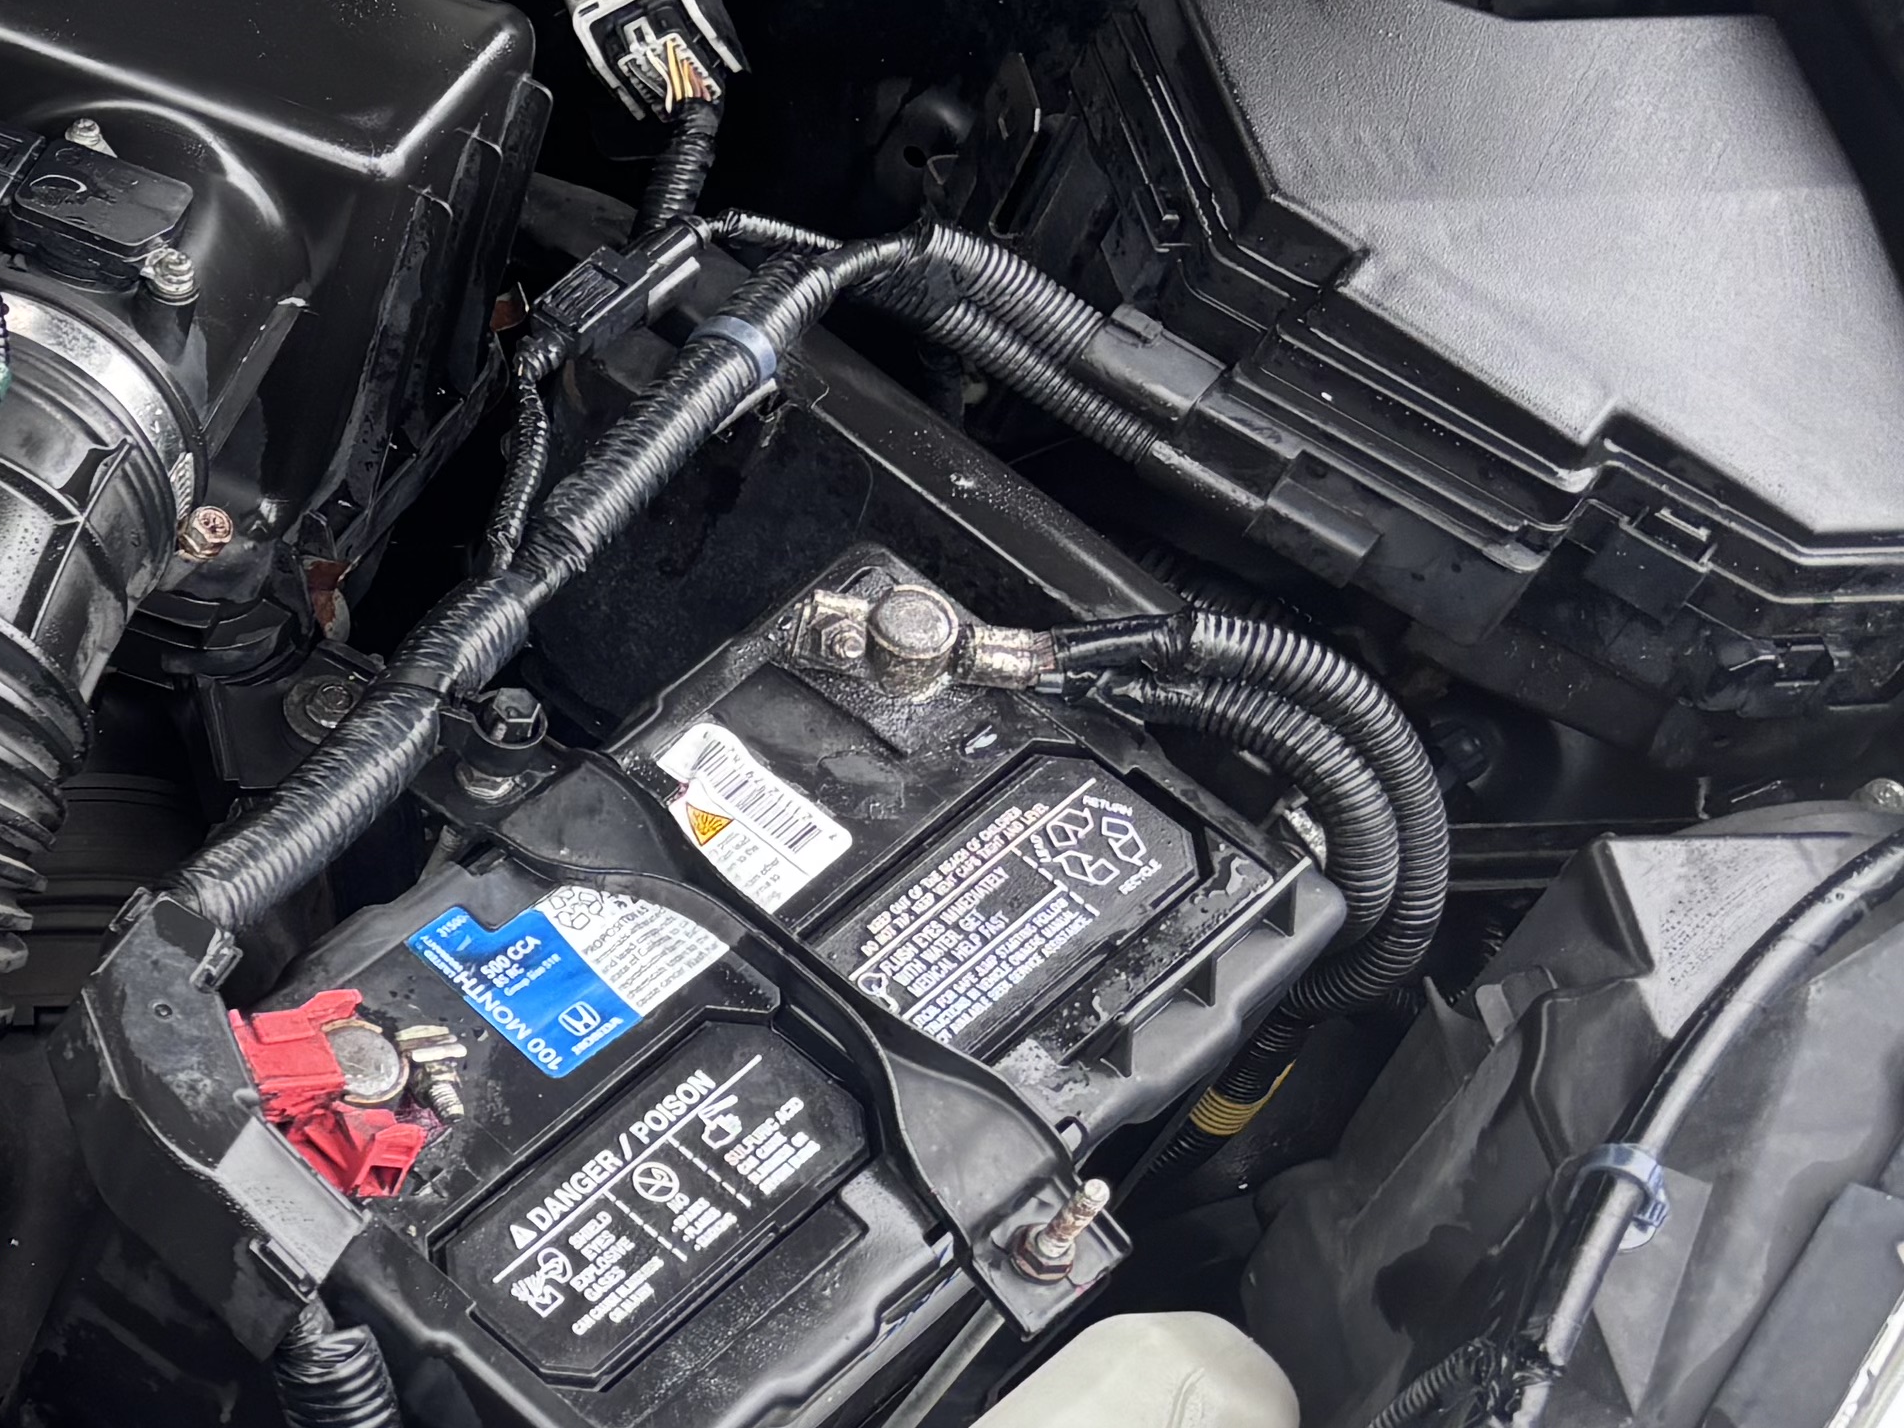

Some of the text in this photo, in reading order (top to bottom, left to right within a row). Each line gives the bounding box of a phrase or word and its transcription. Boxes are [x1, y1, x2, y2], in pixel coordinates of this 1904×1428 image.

[1082, 795, 1133, 817] RETURN
[860, 938, 879, 957] DO
[874, 923, 897, 946] NOT
[1002, 818, 1026, 841] AND
[1118, 858, 1162, 895] RECYCLE
[878, 864, 1010, 978] FLUSH EYES IMMEDIATELY
[892, 955, 927, 988] WITH
[957, 907, 985, 934] GET
[479, 930, 541, 981] 500 CCA
[906, 909, 1010, 999] MEDICAL HELP FAST
[453, 968, 532, 1041] MONTH
[526, 1032, 563, 1071] 100
[524, 1145, 624, 1233] DANGER
[627, 1066, 717, 1146] POISON
[722, 1095, 805, 1167] SULFURIC ACID
[566, 1208, 613, 1251] SHIELD
[666, 1190, 692, 1214] NO
[568, 1234, 636, 1293] EXPLOSIVE
[579, 1227, 617, 1262] EYES
[582, 1263, 627, 1304] GASES
